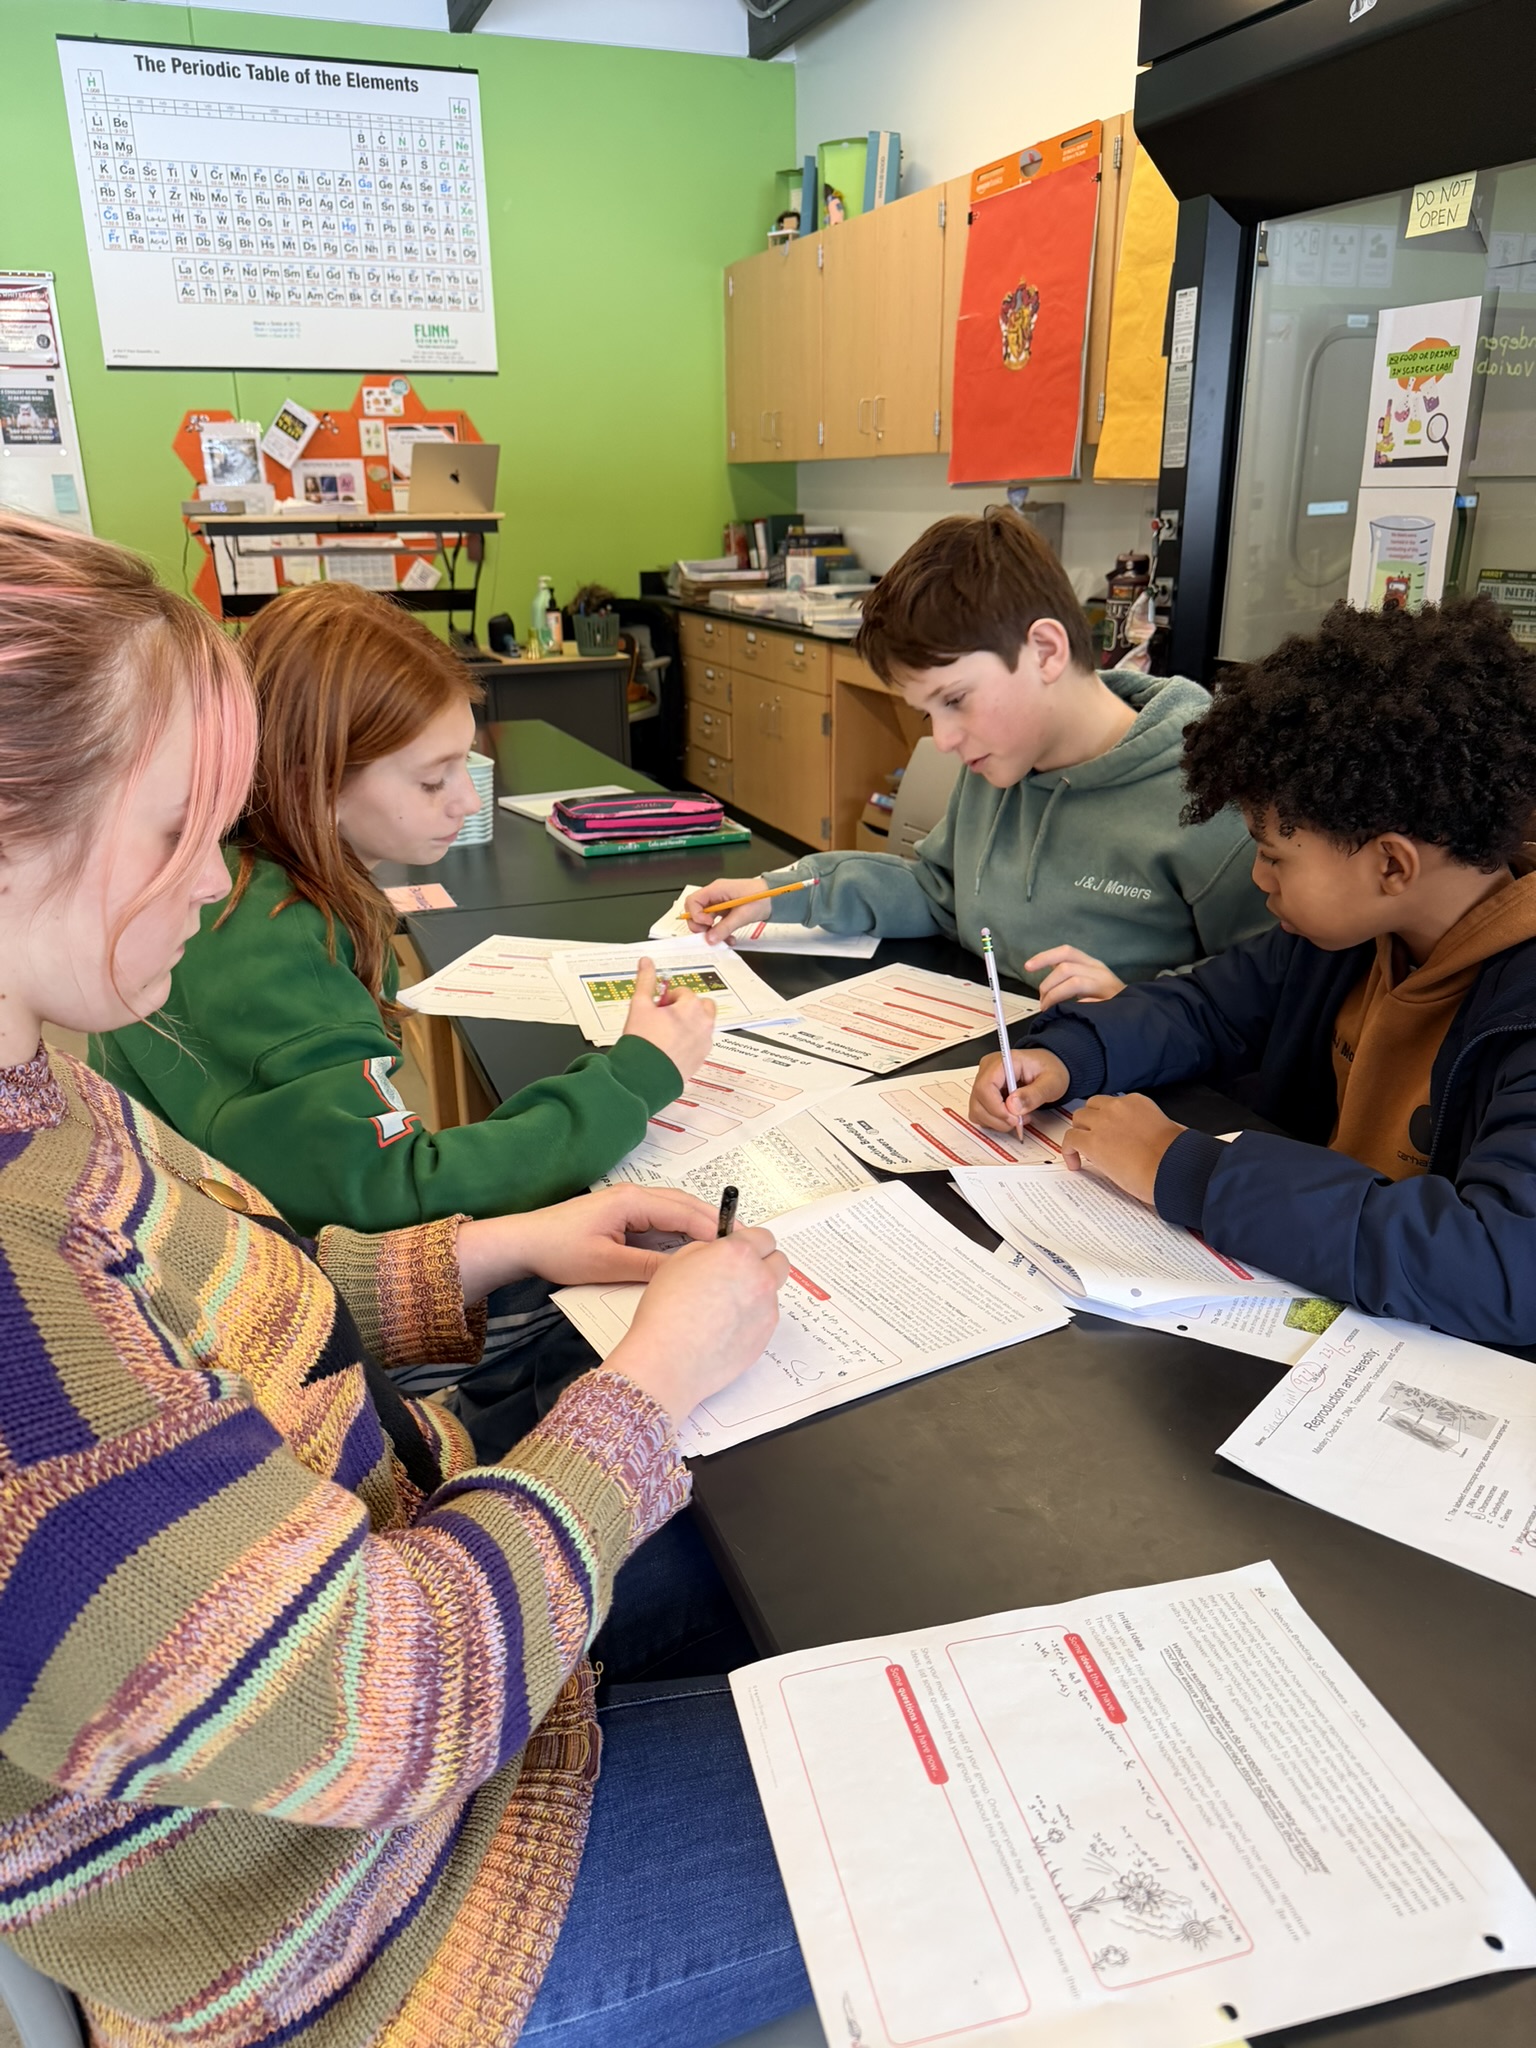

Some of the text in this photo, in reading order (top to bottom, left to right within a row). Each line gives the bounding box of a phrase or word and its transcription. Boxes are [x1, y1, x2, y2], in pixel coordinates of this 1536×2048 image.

[87, 78, 96, 86] H
[134, 54, 419, 92] The Periodic Table of the Elements
[93, 117, 468, 150] Li Be B C N O F Ne
[93, 141, 109, 150] Na
[115, 142, 132, 153] Mg
[379, 158, 389, 167] Si
[421, 161, 428, 170] S
[440, 162, 449, 171] Cl
[459, 163, 469, 172] Ar
[100, 165, 471, 193] K Ca Sc Ti V Cr Mn Fe Co Ni Cu Zn Ga Ge As Se Br Kr
[1416, 178, 1473, 212] DO NOT
[1420, 203, 1460, 229] OPEN
[414, 324, 449, 337] FLINN
[1400, 353, 1418, 362] FOOD
[1419, 352, 1429, 360] OR
[1430, 349, 1457, 359] DRINKS
[1402, 364, 1435, 375] SCIENCE
[1505, 586, 1536, 598] NITR
[1074, 876, 1152, 900] J&J Movers
[712, 1042, 759, 1059] Sunflowers
[721, 1038, 759, 1052] Selective
[761, 1049, 799, 1064] Breeding
[1397, 1150, 1428, 1167] carha
[1303, 1386, 1347, 1432] Reproduction
[1341, 1372, 1357, 1389] and
[1311, 1436, 1331, 1454] Mastery
[1324, 1423, 1340, 1438] Check
[1453, 1492, 1466, 1508] labeled
[1466, 1483, 1485, 1509] DNA strands
[1477, 1484, 1498, 1513] Chromosomes
[1487, 1488, 1509, 1518] Carbohydrates
[1117, 1611, 1145, 1651] Initial Ideas
[1068, 1636, 1082, 1654] Some
[1078, 1654, 1092, 1673] ideas
[1088, 1673, 1103, 1688] that
[1270, 1607, 1294, 1633] Selective
[1290, 1633, 1315, 1661] Breeding
[1311, 1661, 1323, 1669] of
[1317, 1669, 1349, 1704] Sunflowers
[890, 1667, 902, 1686] Some
[896, 1687, 917, 1721] questions
[912, 1722, 921, 1733] we
[917, 1733, 929, 1753] have
[1162, 1647, 1177, 1661] and
[1171, 1660, 1185, 1675] then
[1180, 1676, 1199, 1698] ensure
[1195, 1698, 1210, 1713] that
[1204, 1713, 1216, 1725] the
[1212, 1725, 1226, 1740] new
[1222, 1741, 1243, 1766] variety
[1239, 1767, 1255, 1785] stays
[1252, 1786, 1265, 1799] the
[1170, 1642, 1187, 1659] What
[1182, 1660, 1194, 1672] can
[1190, 1672, 1214, 1703] sunflower
[1210, 1704, 1234, 1733] breeders
[1230, 1734, 1241, 1744] do
[1242, 1754, 1262, 1777] create
[1262, 1784, 1278, 1799] new
[1274, 1801, 1297, 1827] variety
